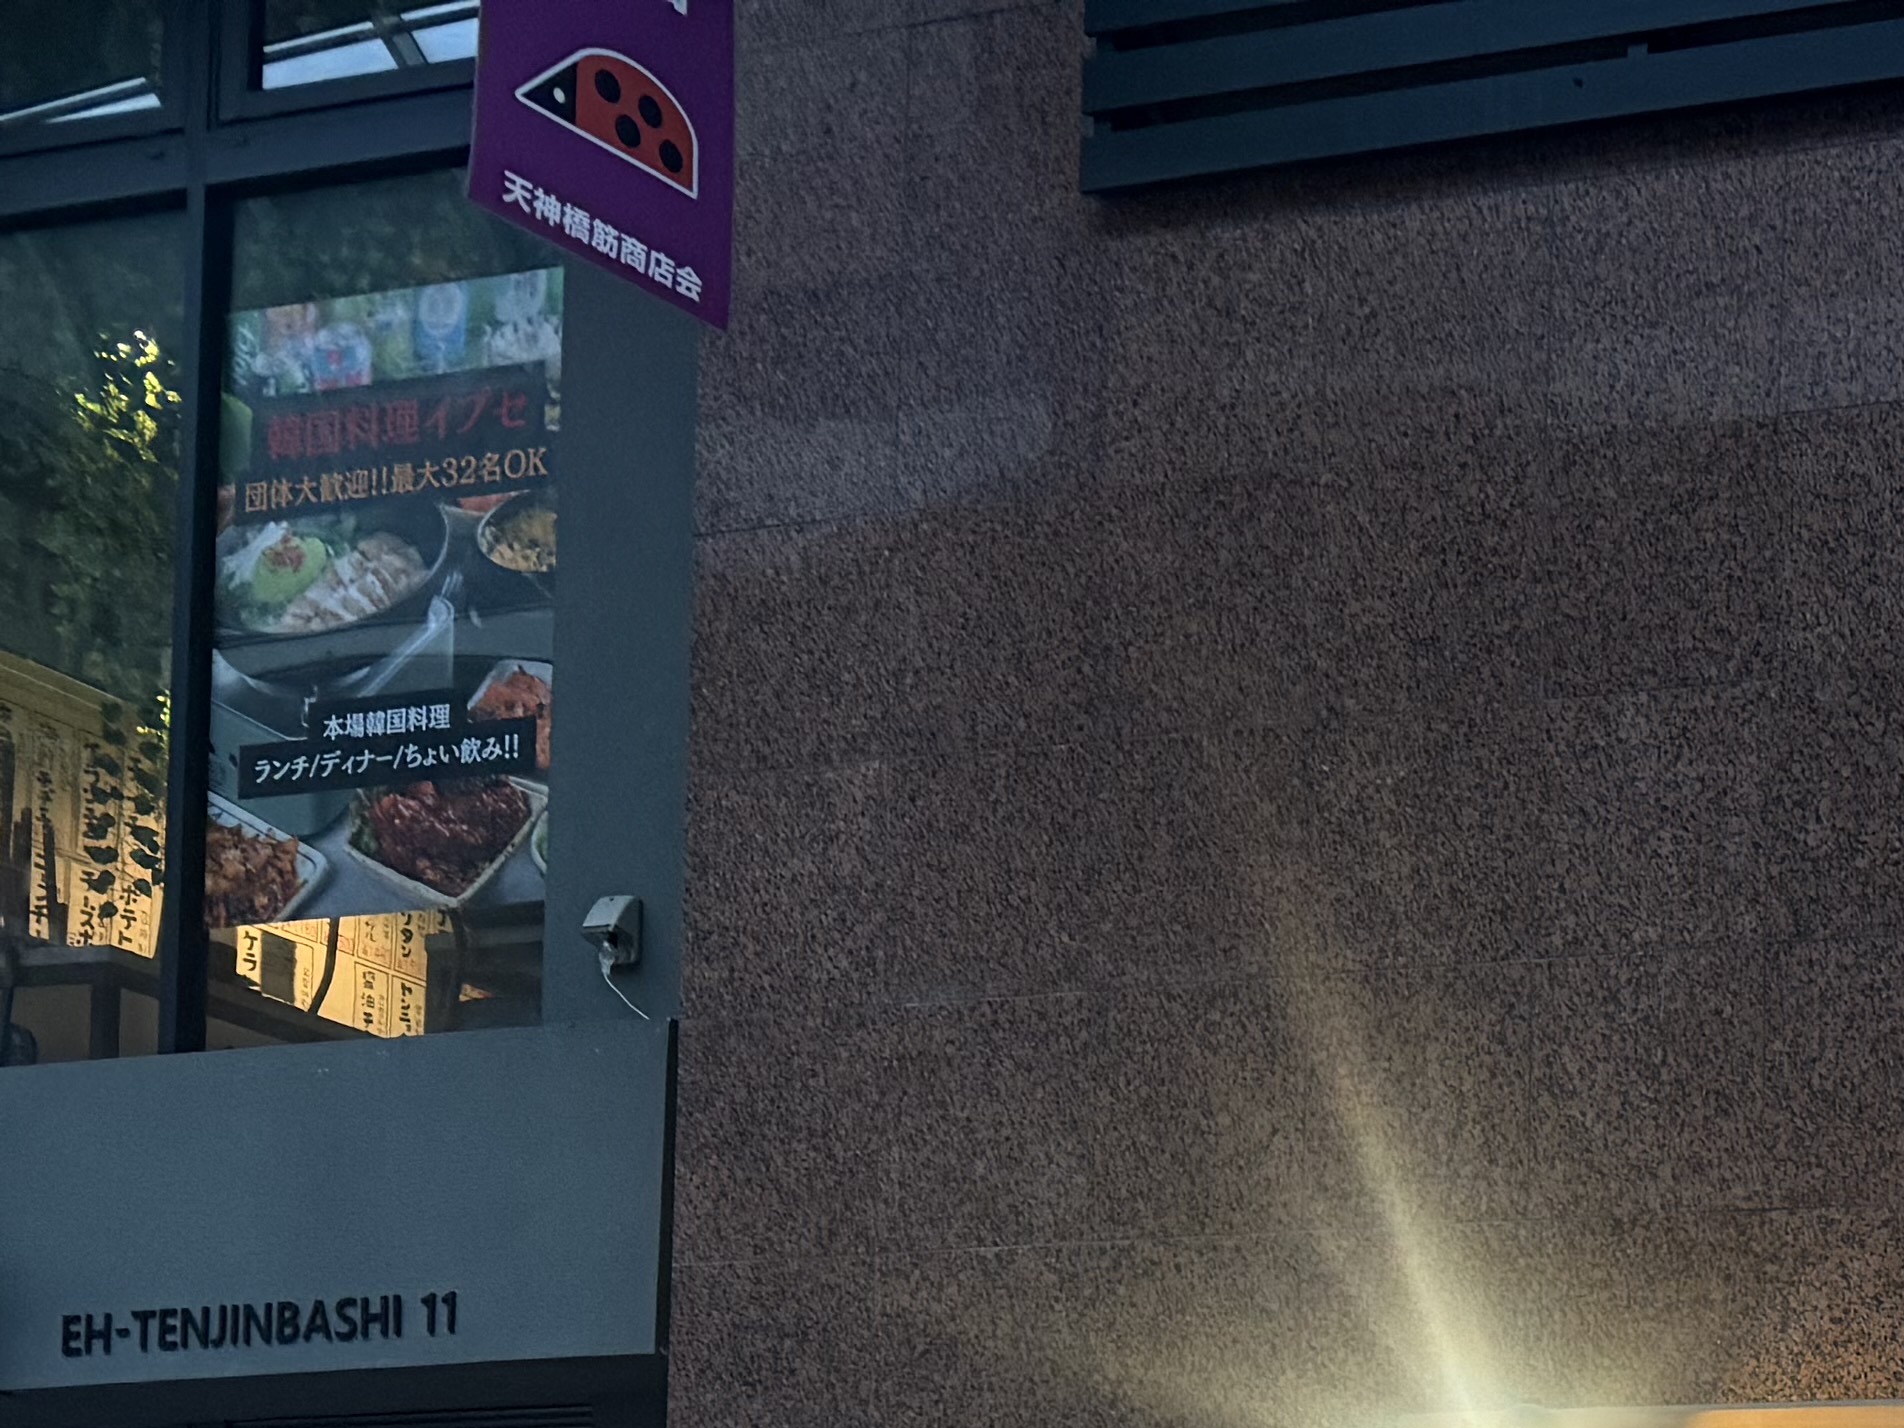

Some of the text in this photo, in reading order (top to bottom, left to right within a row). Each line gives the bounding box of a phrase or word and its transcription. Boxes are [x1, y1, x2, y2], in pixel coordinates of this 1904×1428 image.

[502, 169, 703, 303] 天神橋筋商店会
[322, 703, 451, 741] 本場韓国料理
[61, 1291, 458, 1358] EH-TENJINBASHI 11
